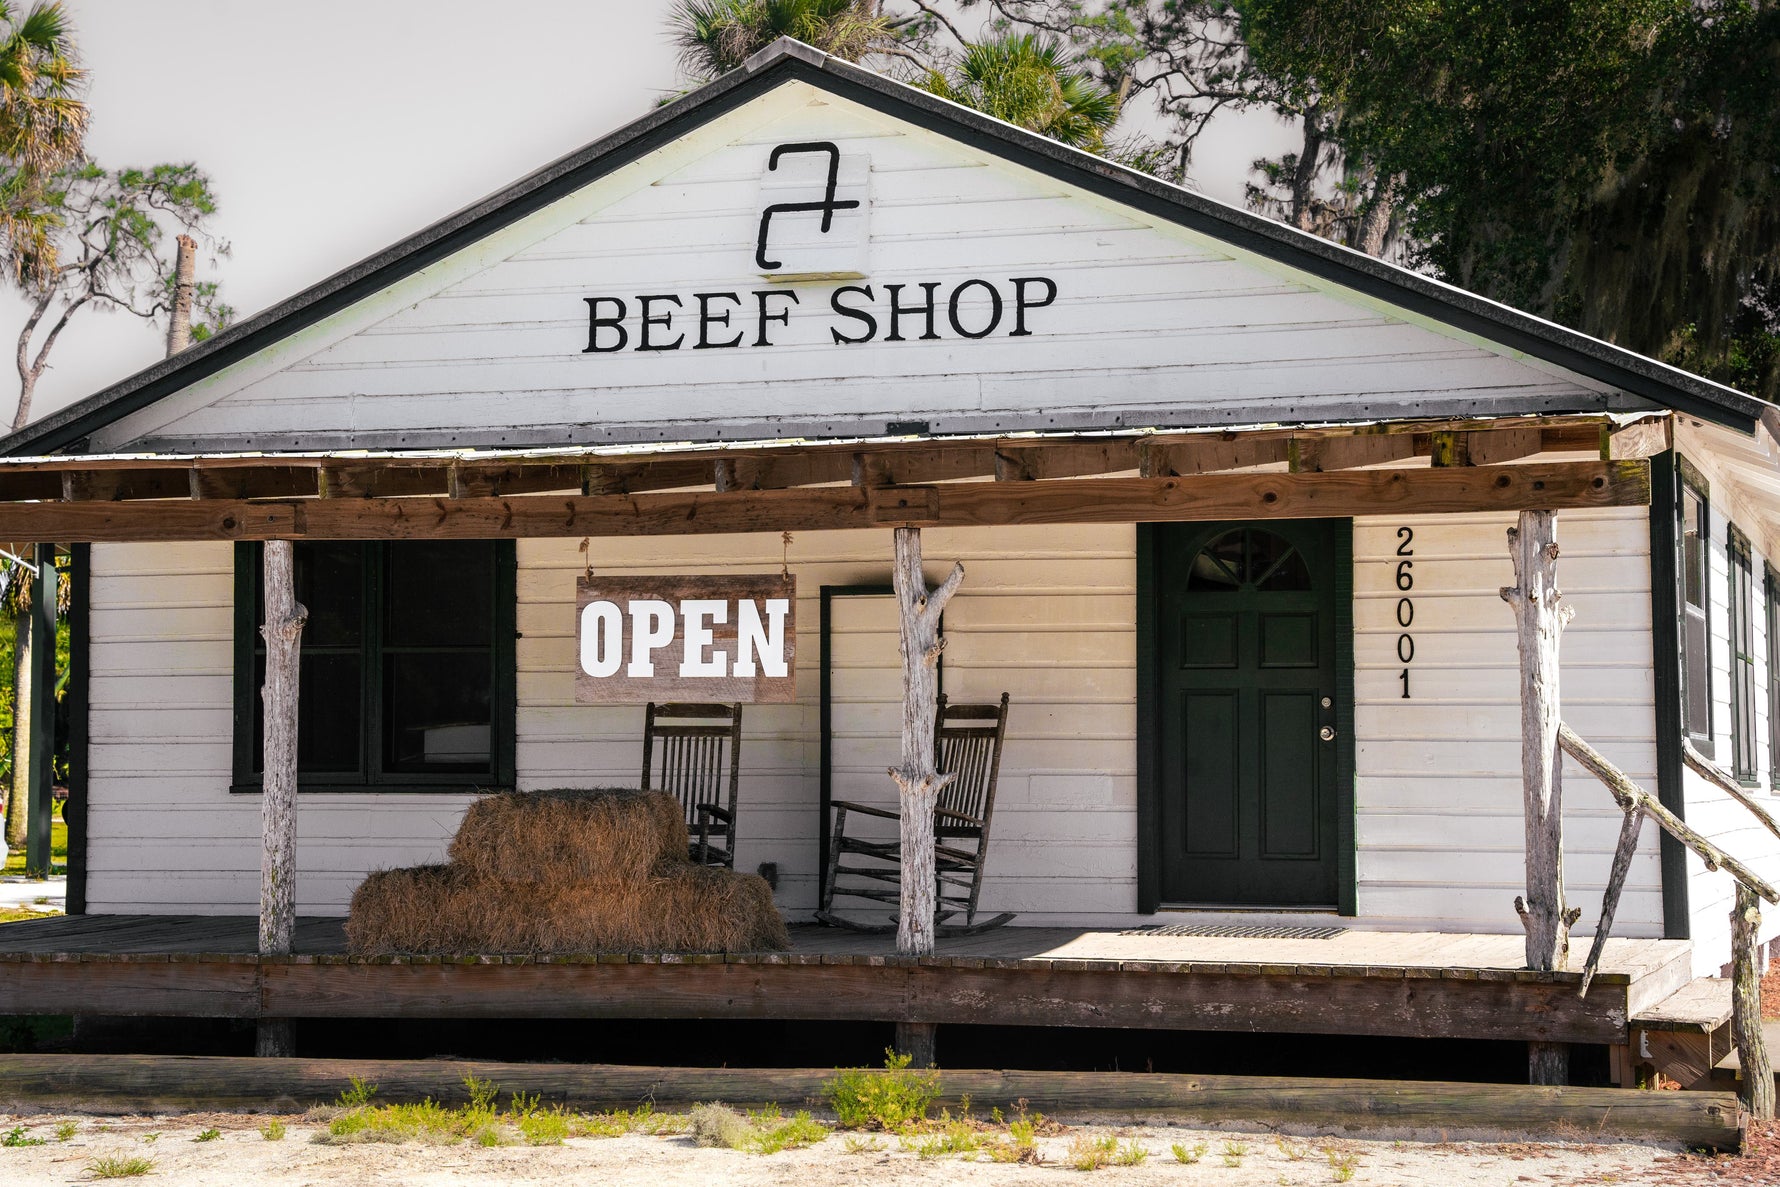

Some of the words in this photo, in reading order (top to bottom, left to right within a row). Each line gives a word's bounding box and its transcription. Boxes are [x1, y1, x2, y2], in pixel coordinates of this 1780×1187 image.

[582, 289, 800, 354] BEEF
[830, 276, 1058, 346] SHOP
[580, 598, 790, 678] OPEN
[1396, 526, 1415, 699] 26001
